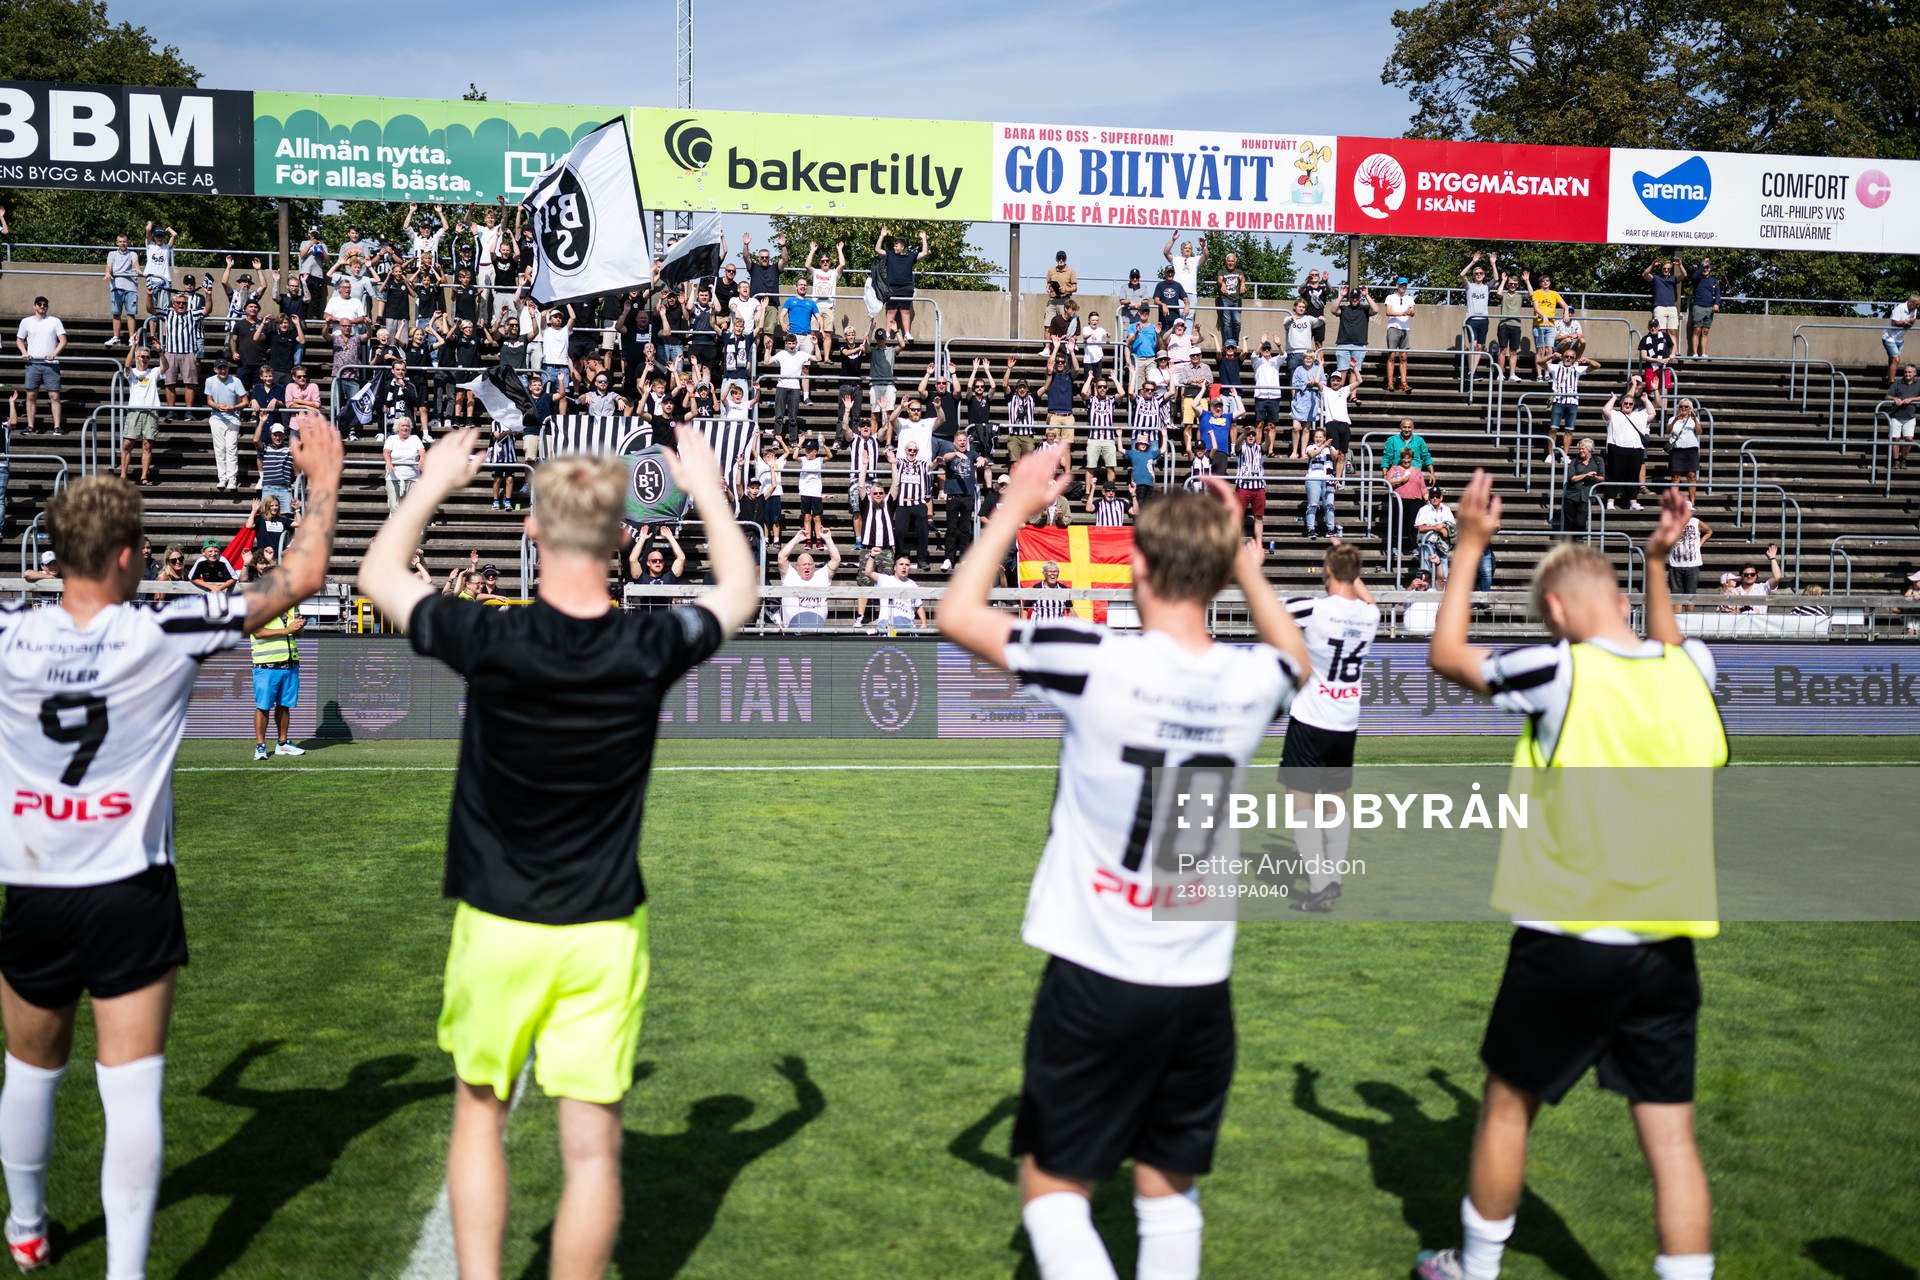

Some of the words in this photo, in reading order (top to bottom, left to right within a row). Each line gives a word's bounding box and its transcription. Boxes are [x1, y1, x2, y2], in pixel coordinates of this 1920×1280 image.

[0, 87, 214, 167] BBM
[1004, 127, 1036, 140] BARA
[1040, 129, 1062, 142] HOS
[1066, 130, 1089, 143] OSS
[1100, 131, 1174, 147] SUPERFOAM!
[275, 138, 370, 161] Allmän
[377, 145, 452, 167] nytta.
[1241, 138, 1298, 151] HUNDTVÄTT
[29, 165, 78, 181] BYGG
[83, 168, 96, 182] &
[100, 169, 187, 186] MONTAGE
[192, 173, 214, 187] AB
[275, 164, 320, 185] För
[325, 166, 386, 188] allas
[728, 147, 963, 209] bakertilly
[1005, 145, 1064, 195] GO
[1078, 145, 1274, 202] BILTVÄTT
[1762, 172, 1850, 200] COMFORT
[1003, 202, 1025, 220] NU
[1031, 200, 1076, 222] BÅDE
[1082, 202, 1102, 224] PÅ
[1108, 204, 1203, 227] PJÄSGATAN
[1207, 213, 1220, 227] &
[1226, 214, 1333, 231] PUMPGATAN!
[1416, 197, 1422, 211] I
[1424, 195, 1476, 213] SKÅNE
[1761, 204, 1823, 220] CARL-PHILIPS
[1825, 206, 1845, 221] VVS
[1625, 229, 1641, 237] PART
[1641, 229, 1650, 237] OF
[1650, 230, 1670, 239] HEAVY
[1671, 231, 1693, 239] RENTAL
[1694, 232, 1715, 240] GROUP
[1760, 223, 1832, 241] CENTRALVÄRME
[1327, 637, 1368, 683] 16
[46, 667, 100, 683] IHLER
[38, 692, 110, 787] 9
[12, 789, 133, 823] PULS
[1120, 745, 1237, 873] 10
